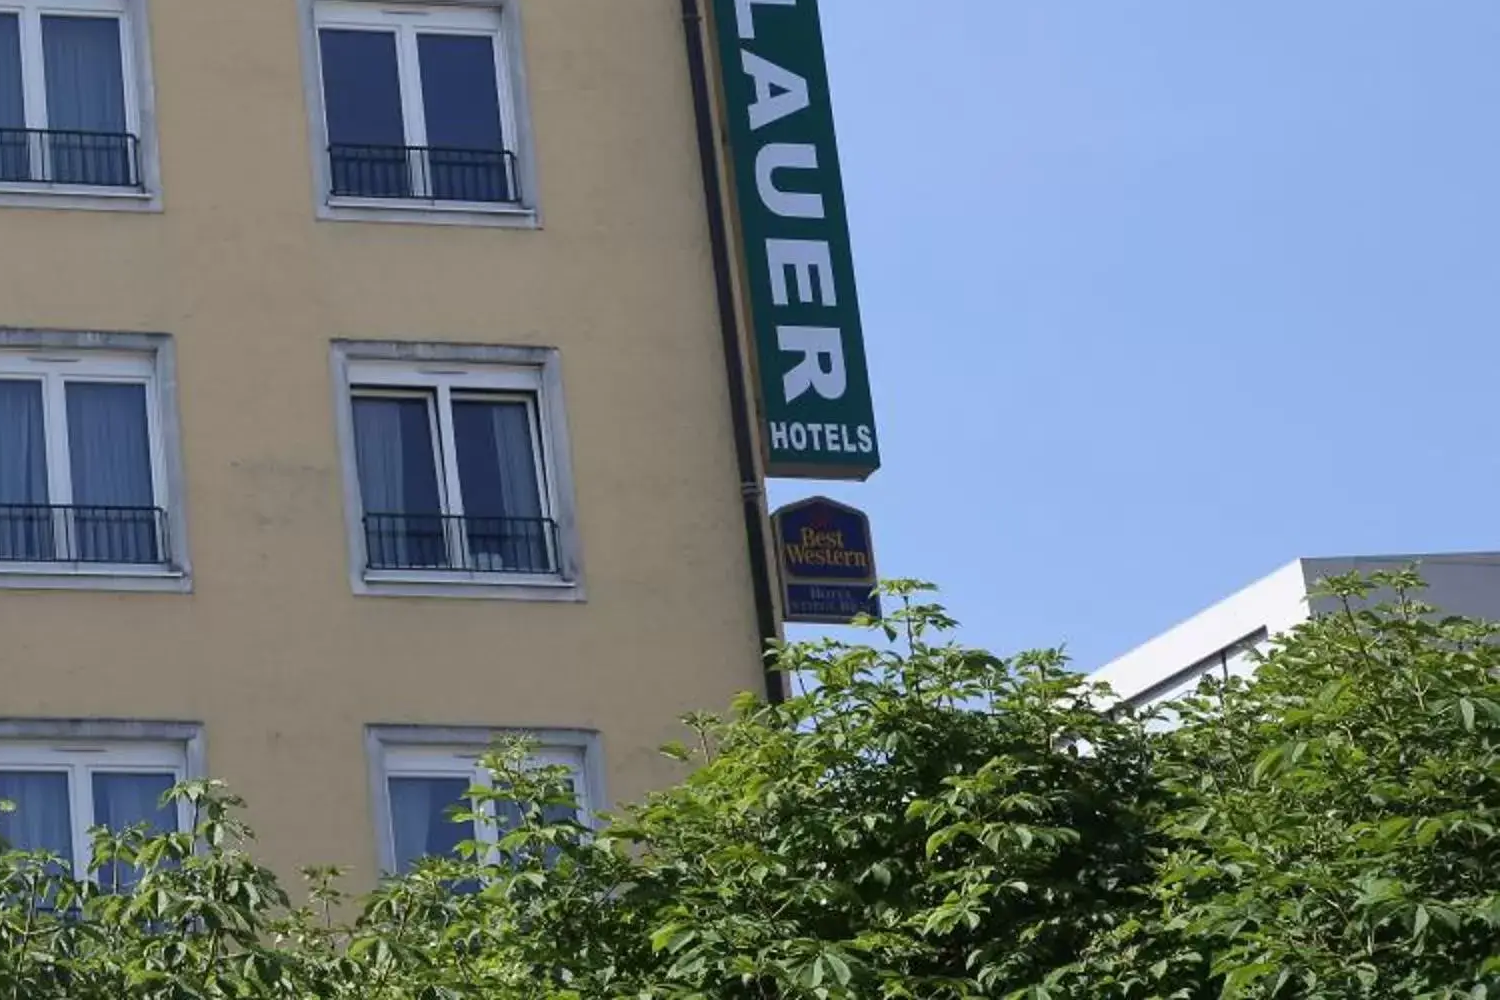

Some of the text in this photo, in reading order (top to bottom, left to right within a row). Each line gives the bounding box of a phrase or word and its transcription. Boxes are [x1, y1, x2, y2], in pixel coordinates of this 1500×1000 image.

[770, 421, 873, 453] HOTELS
[800, 526, 844, 549] Best
[787, 542, 868, 568] Western
